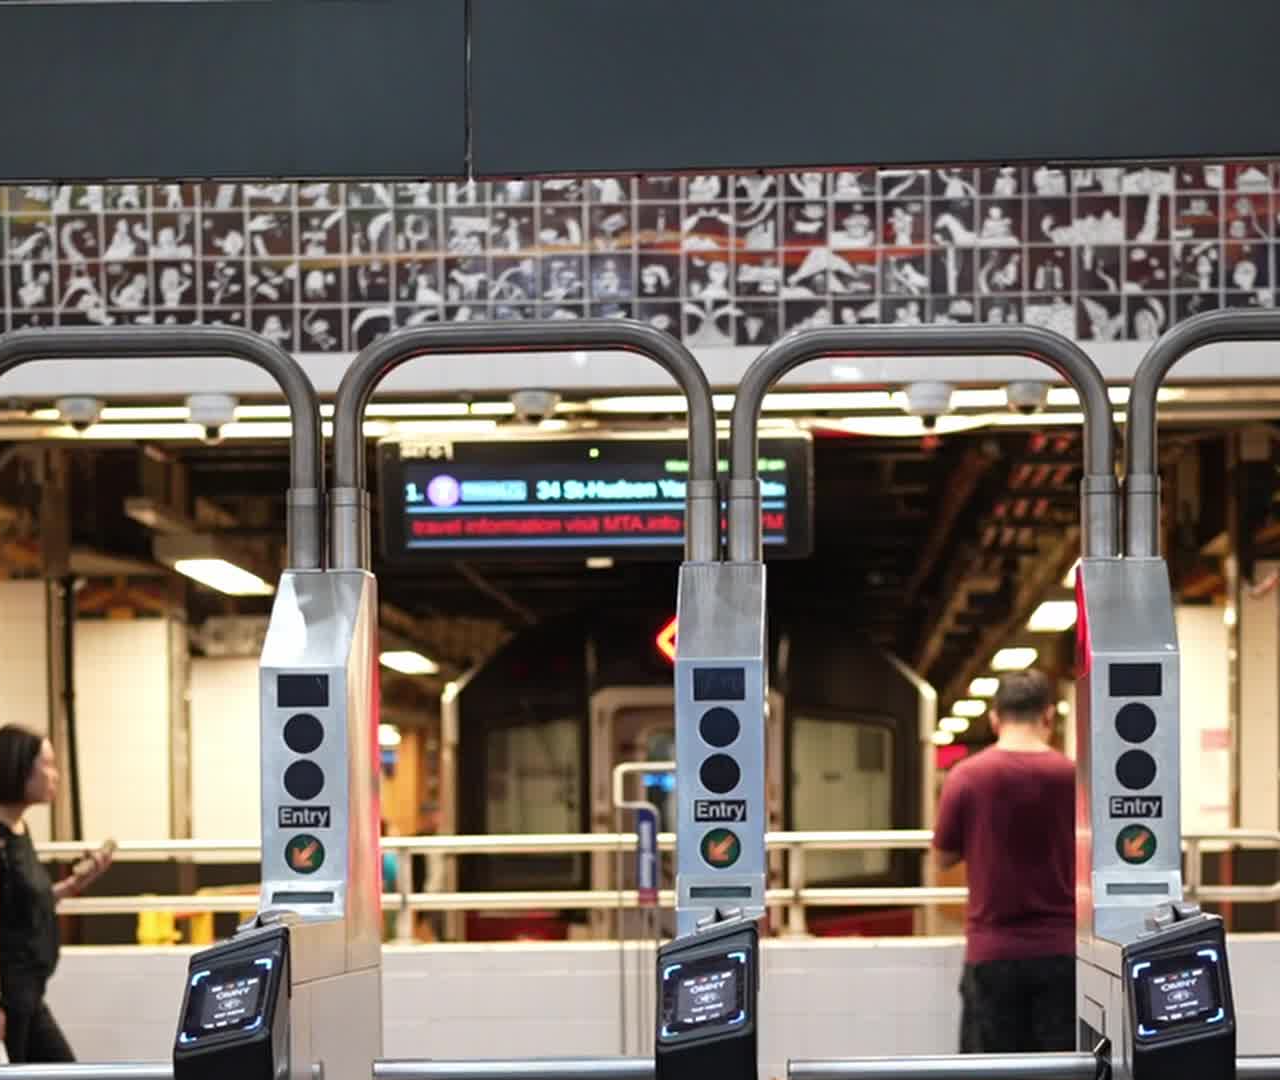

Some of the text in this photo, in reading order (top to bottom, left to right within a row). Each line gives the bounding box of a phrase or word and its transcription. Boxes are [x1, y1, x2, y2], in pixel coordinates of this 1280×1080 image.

[697, 802, 745, 821] Entry
[1111, 798, 1160, 816] Entry
[281, 808, 328, 826] Entry
